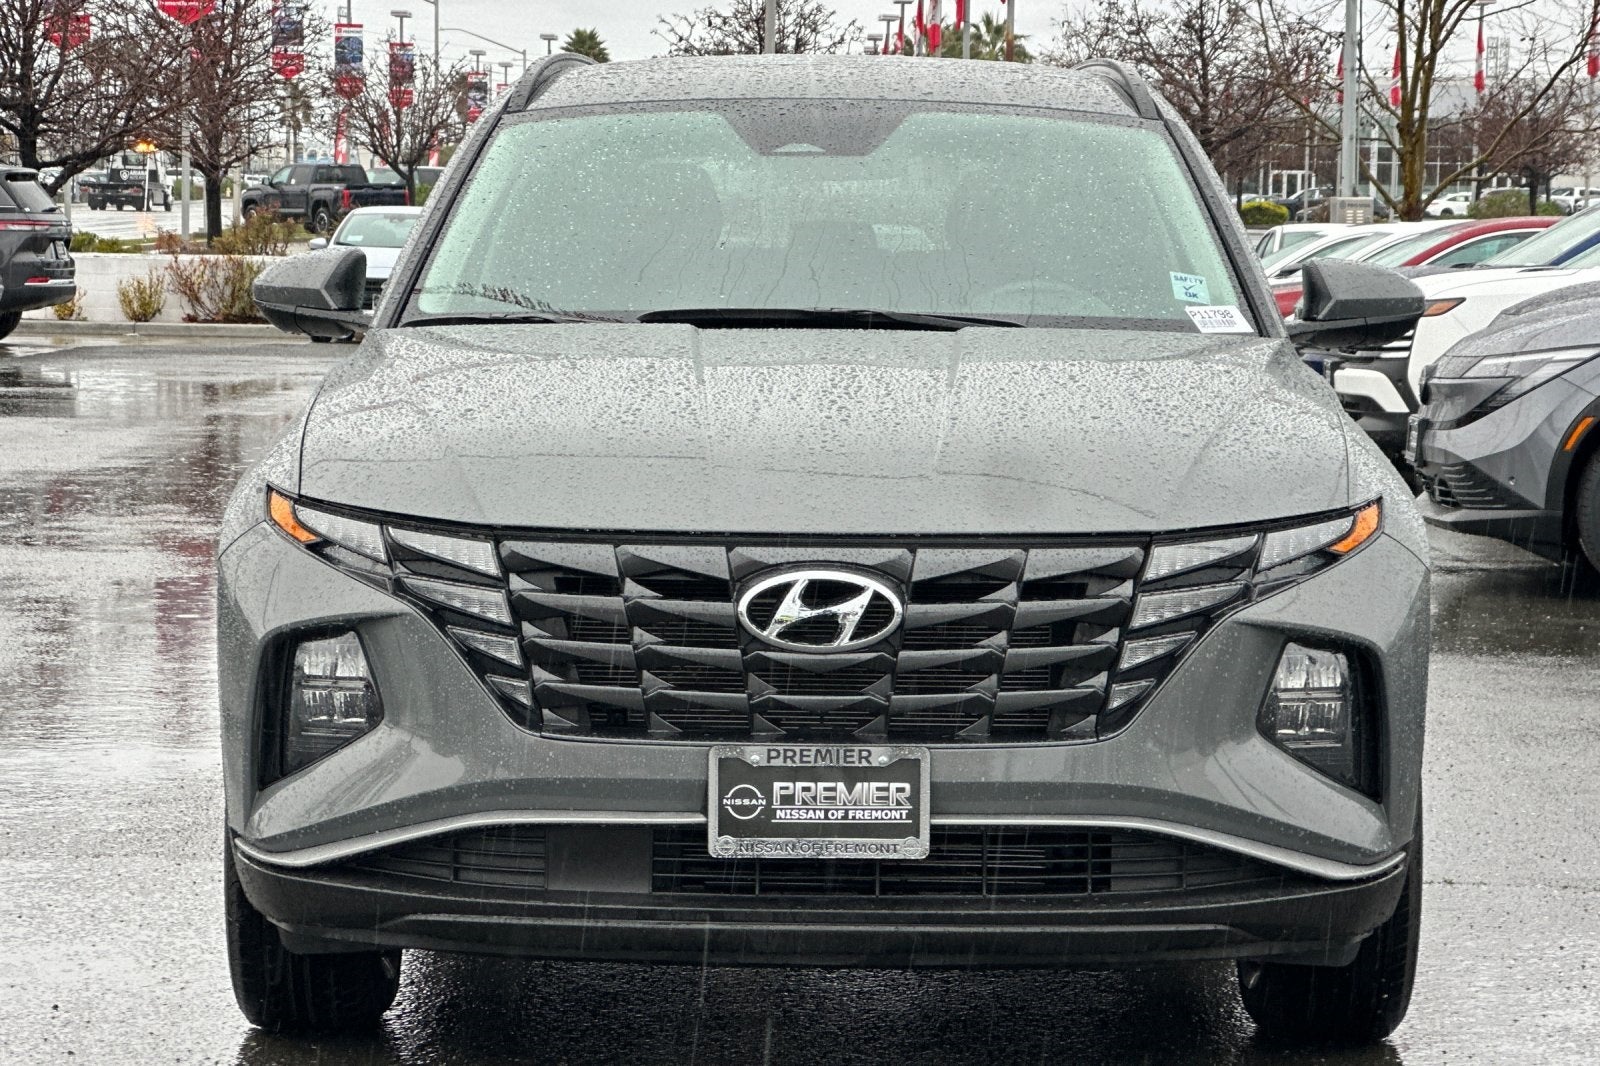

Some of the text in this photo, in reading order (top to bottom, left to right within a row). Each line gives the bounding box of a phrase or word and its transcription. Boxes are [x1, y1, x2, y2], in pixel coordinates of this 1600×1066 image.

[1173, 274, 1204, 285] SAFETY
[1188, 309, 1234, 319] P11798
[767, 748, 872, 764] PREMIER
[772, 781, 911, 806] PREMIER
[776, 809, 909, 819] NISSAN OF FREMONT
[739, 842, 900, 855] NISSAN OF FREMONT
